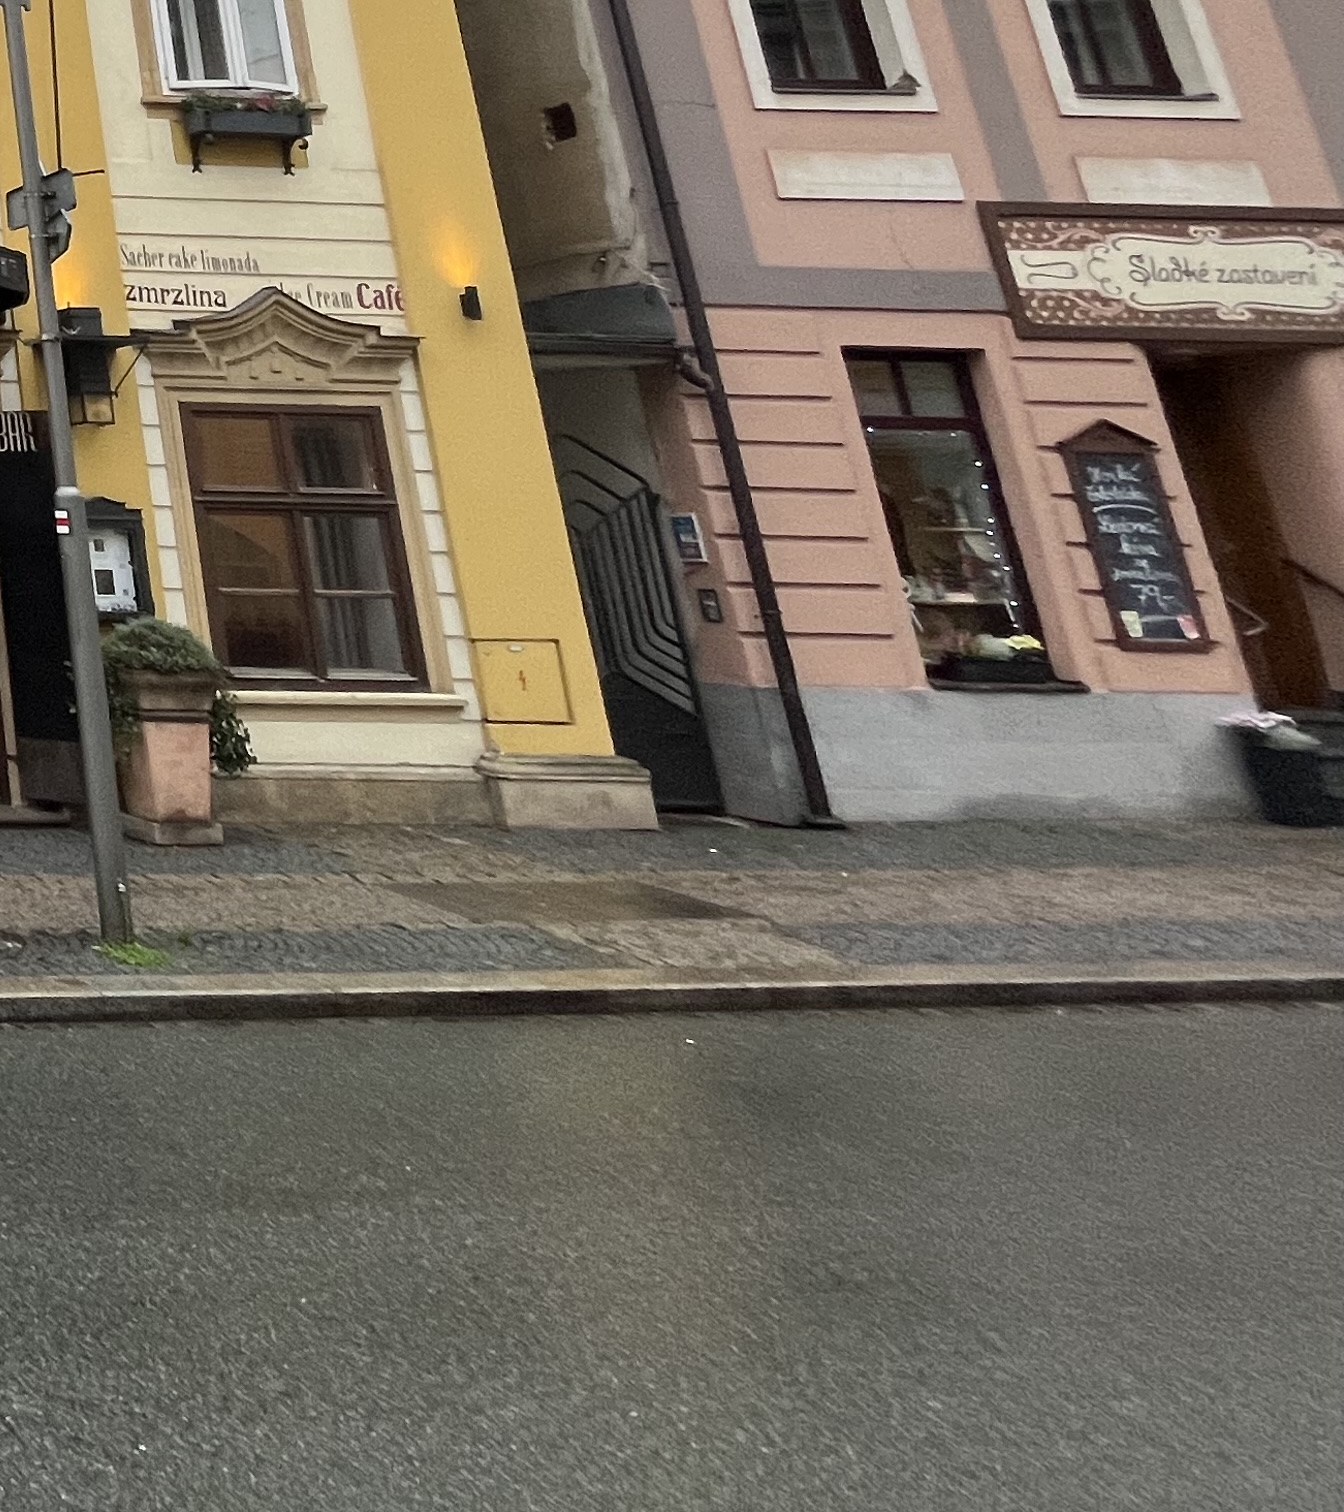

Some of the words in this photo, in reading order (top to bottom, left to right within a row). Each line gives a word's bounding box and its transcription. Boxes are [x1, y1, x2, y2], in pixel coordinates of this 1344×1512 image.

[119, 243, 165, 269] Sacher
[168, 245, 198, 270] cake
[200, 248, 261, 273] limonada
[1128, 254, 1210, 288] Sladké
[1216, 263, 1318, 287] zastavení
[124, 283, 227, 308] zmrzlina
